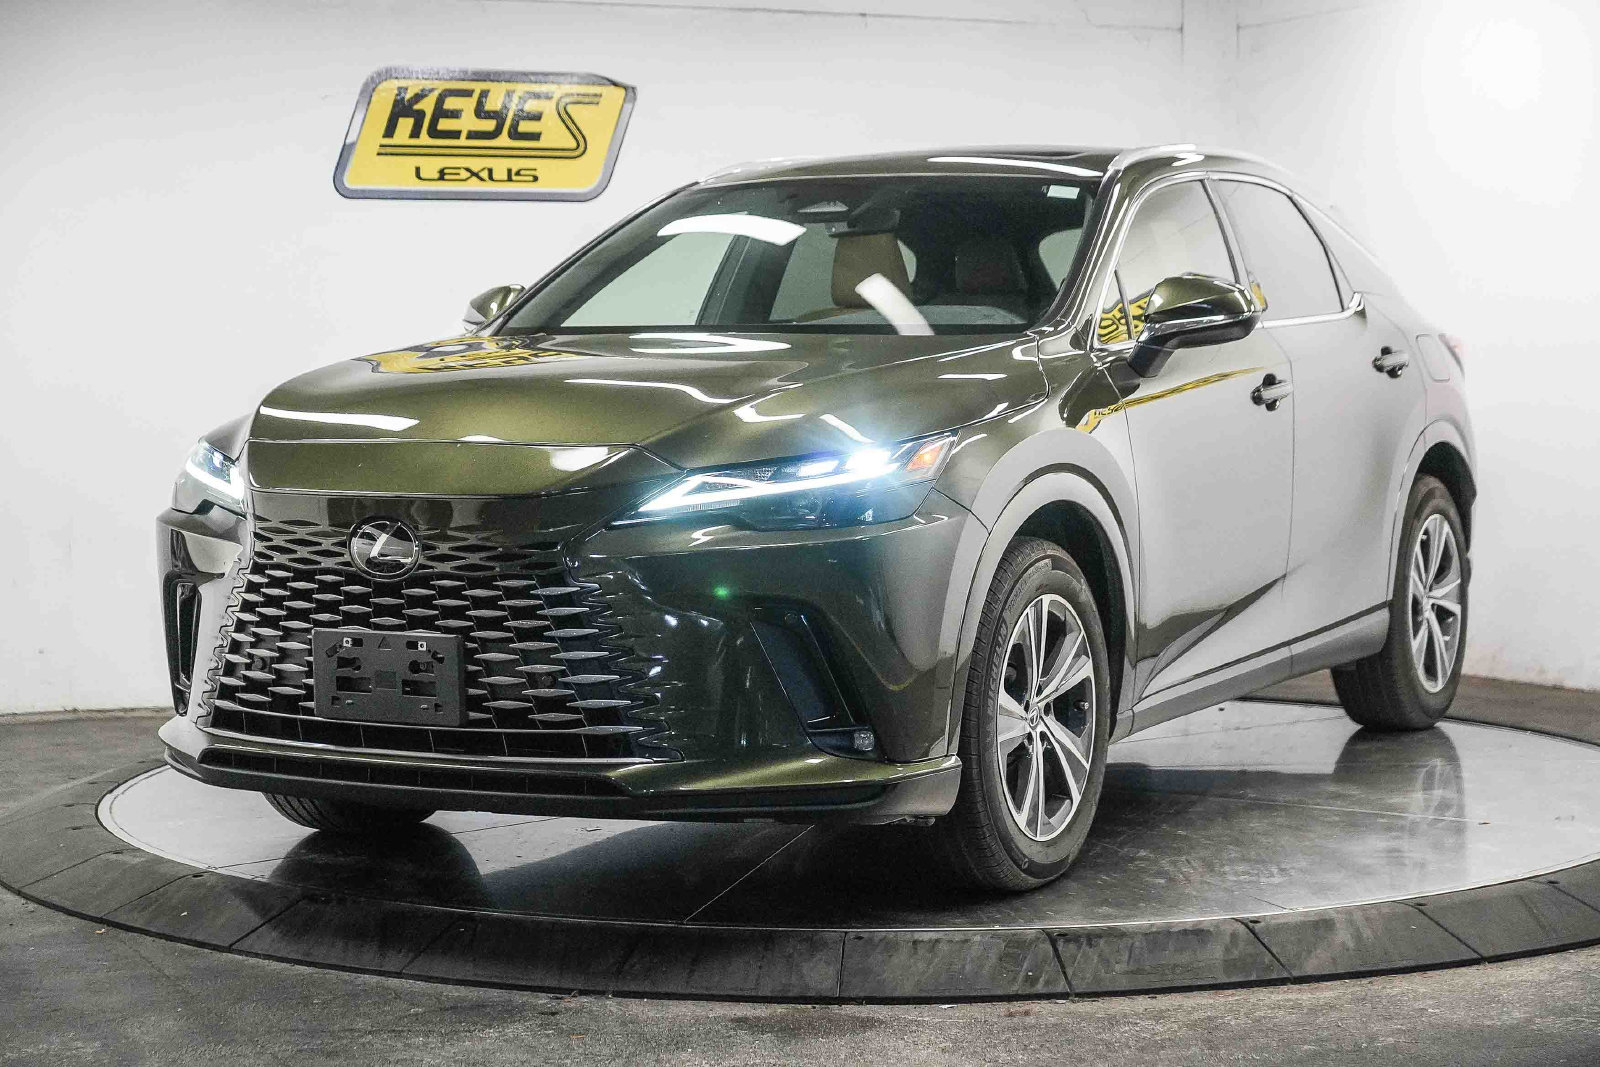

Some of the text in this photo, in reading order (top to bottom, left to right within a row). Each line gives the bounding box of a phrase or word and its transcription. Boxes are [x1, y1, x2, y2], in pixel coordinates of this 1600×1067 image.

[377, 86, 602, 159] KEYES
[415, 166, 538, 182] LEXUS
[987, 622, 1007, 716] MICHELIN
